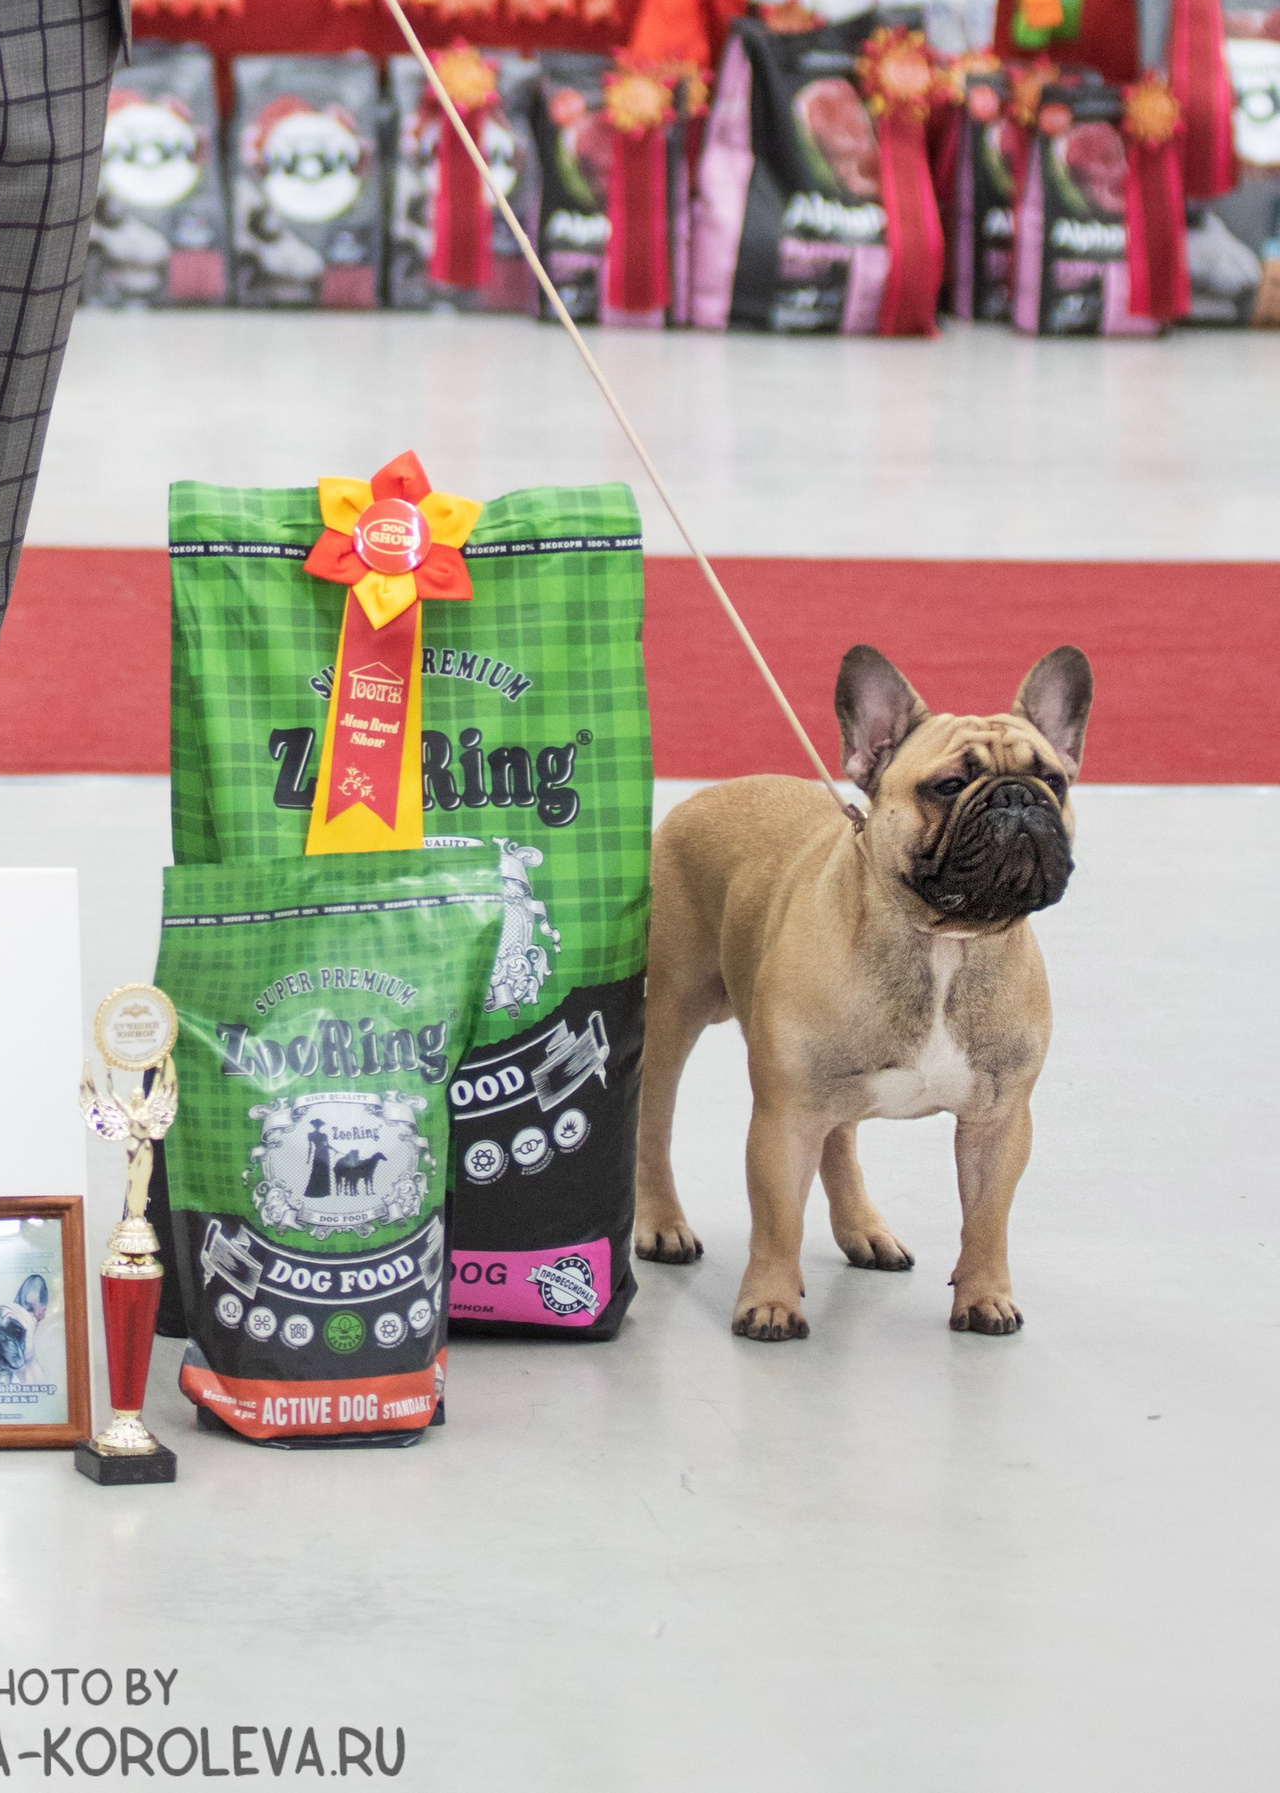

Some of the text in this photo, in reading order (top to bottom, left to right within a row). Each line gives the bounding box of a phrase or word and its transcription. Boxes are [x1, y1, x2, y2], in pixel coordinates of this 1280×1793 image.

[381, 523, 406, 534] DOG
[370, 531, 415, 547] SHOW
[465, 545, 507, 555] ЭКОКОРМ
[512, 543, 535, 552] 100%
[540, 540, 583, 550] ЭКОКОРМ
[587, 540, 611, 548] 100%
[169, 545, 307, 556] КОКОРМ 100% ЭКОКОРМ 100%
[421, 647, 533, 702] REMIUM
[340, 713, 400, 735] Mono Breed
[349, 731, 386, 749] Show
[422, 839, 470, 848] UALITY
[198, 917, 217, 925] 100%
[253, 913, 271, 921] 100%
[302, 907, 319, 915] 100%
[359, 903, 379, 911] 100%
[255, 966, 419, 1016] SUPER PREMIUM
[450, 1065, 525, 1107] OOD
[329, 1093, 368, 1101] QUALITY
[319, 1212, 369, 1223] DOG FOOD
[267, 1254, 415, 1293] DOG FOOD
[562, 1258, 590, 1281] SUPER
[539, 1268, 594, 1304] ПРОФЕССИОНАЛ
[7, 1382, 58, 1396] Юниор
[261, 1393, 432, 1426] ACTIVE DOG STANDART
